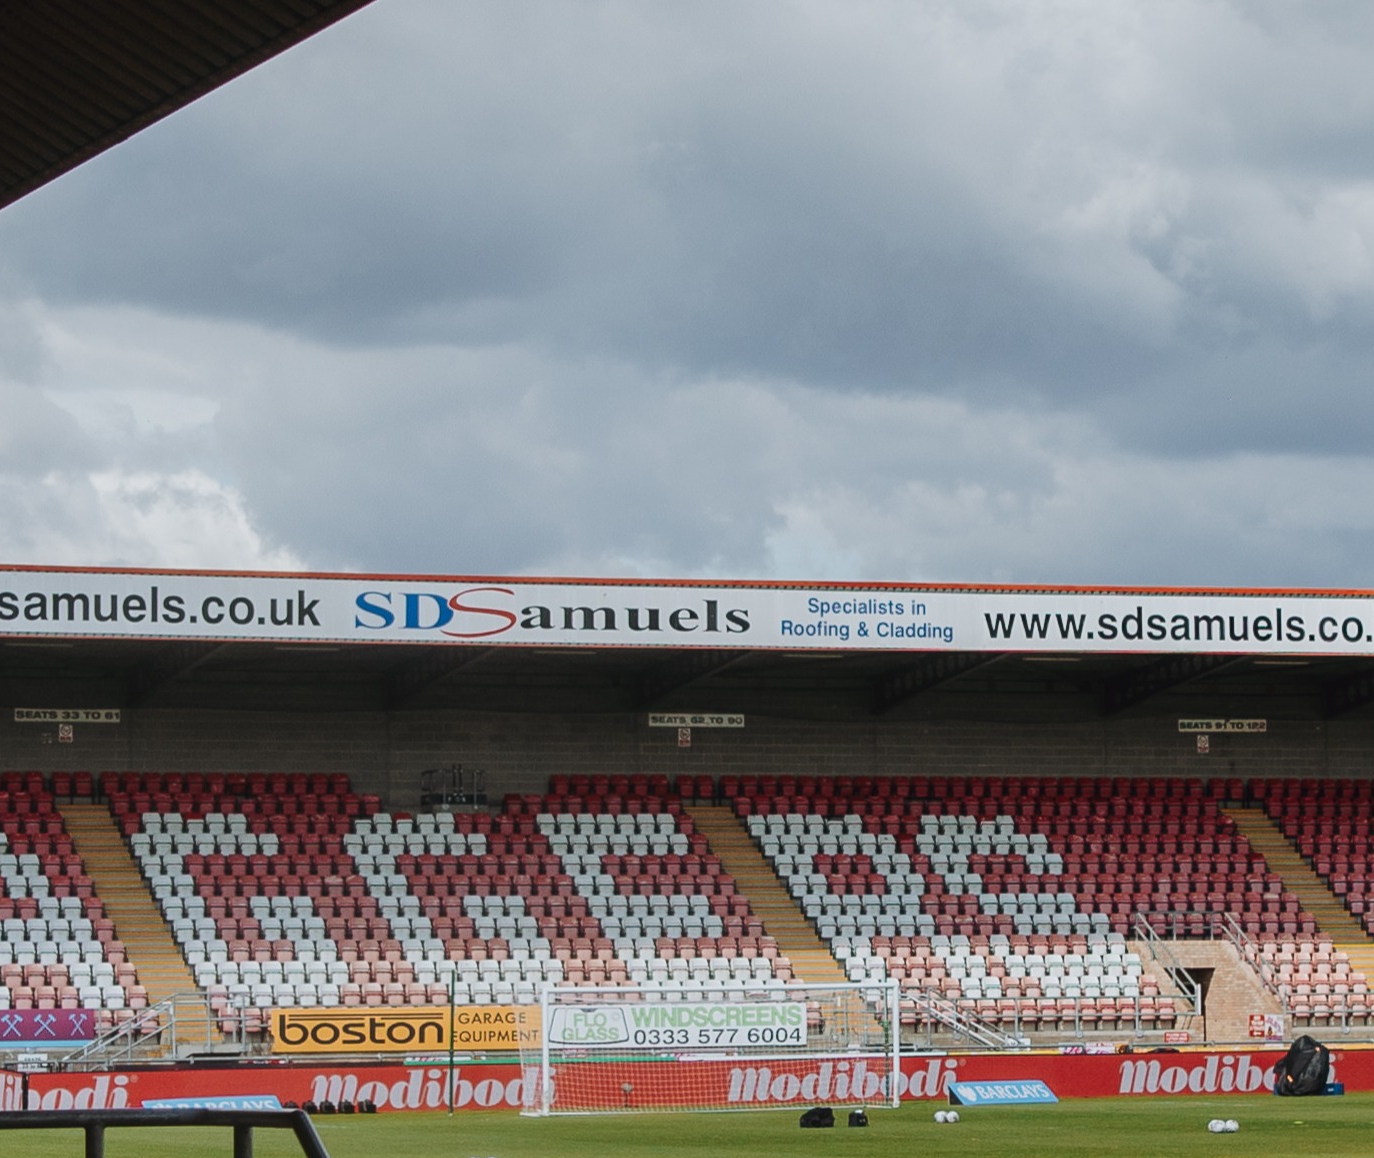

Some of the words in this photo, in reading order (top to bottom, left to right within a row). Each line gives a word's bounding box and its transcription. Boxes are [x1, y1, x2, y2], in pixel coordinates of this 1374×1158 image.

[807, 597, 905, 618] Specialists
[911, 598, 927, 616] in
[780, 620, 850, 640] Roofing
[858, 621, 870, 638] &
[876, 621, 954, 642] Cladding
[15, 710, 58, 719] SEATS
[61, 711, 80, 719] 33
[83, 711, 102, 720] TO
[650, 715, 687, 725] SEATS
[710, 716, 724, 725] TO
[1179, 721, 1213, 730] SEATS
[1231, 722, 1244, 730] TO
[457, 1011, 527, 1026] GARAGE
[573, 1012, 608, 1029] FLO
[630, 1004, 803, 1028] WINDSCREENS
[278, 1013, 444, 1046] boston
[452, 1029, 539, 1044] EQUIPMENT
[562, 1027, 620, 1043] GLASS
[634, 1027, 690, 1047] 0333
[696, 1026, 737, 1046] 577
[746, 1026, 803, 1045] 6004
[975, 1082, 1052, 1102] BARCLAYS
